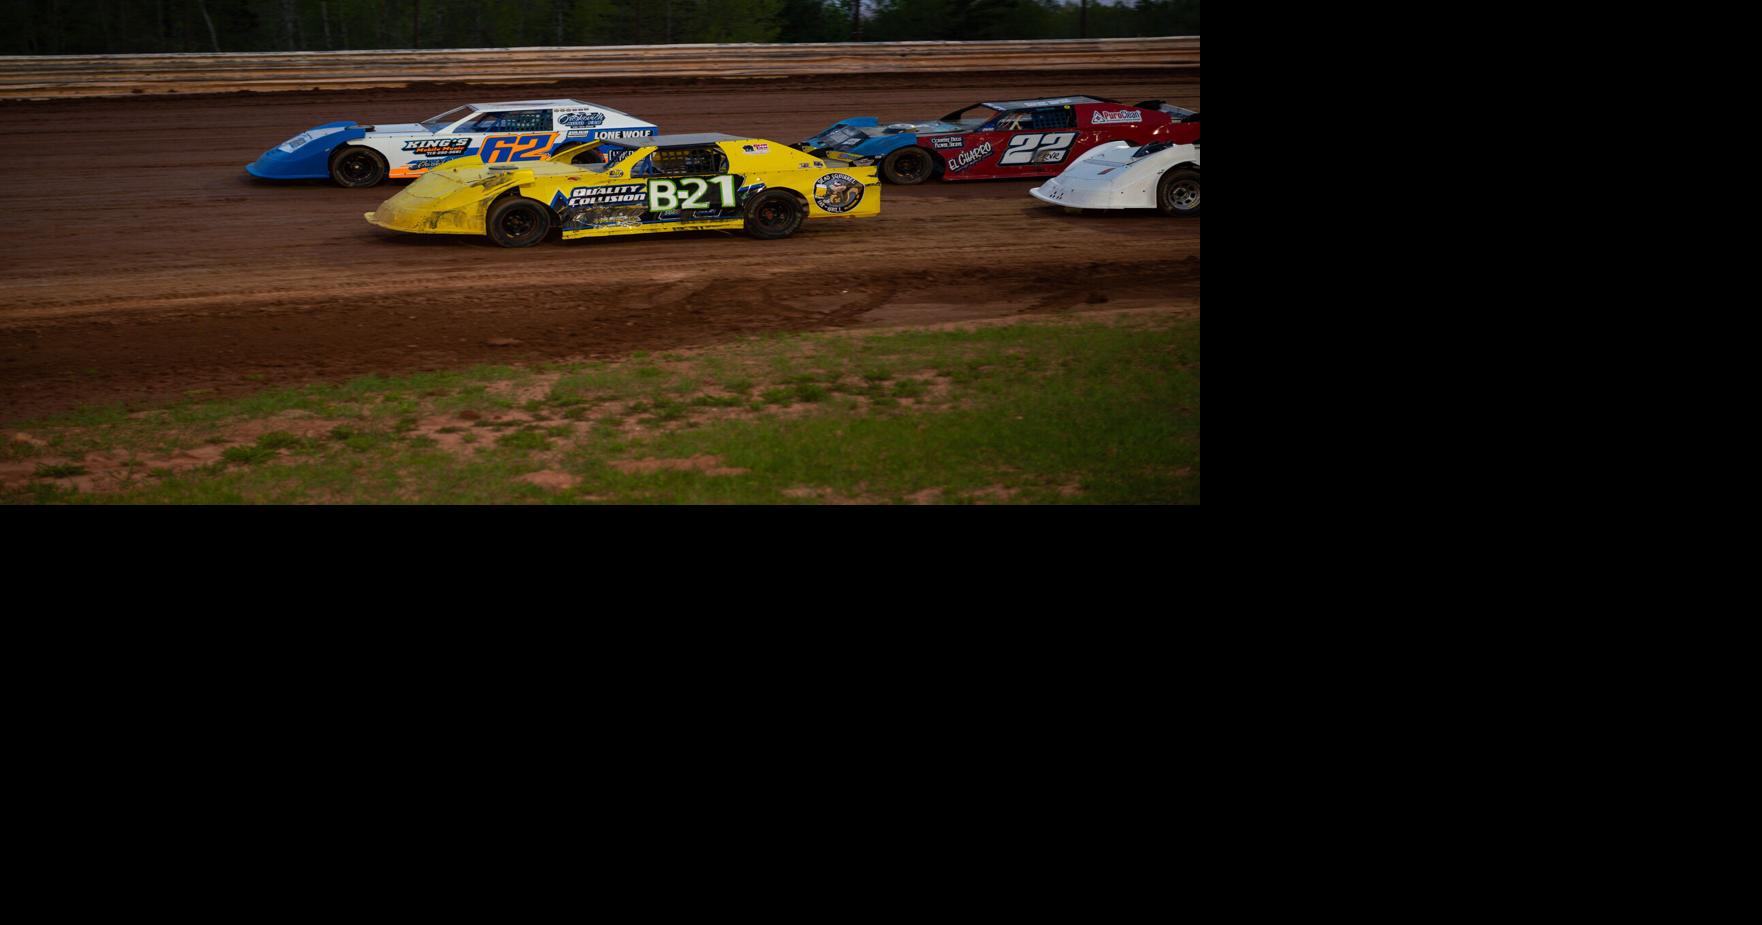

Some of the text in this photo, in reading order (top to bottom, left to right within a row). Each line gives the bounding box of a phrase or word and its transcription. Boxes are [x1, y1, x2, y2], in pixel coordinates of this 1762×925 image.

[405, 138, 469, 149] KING'S
[594, 131, 620, 140] LONE
[622, 130, 651, 138] WOLF
[479, 132, 560, 163] 62
[948, 142, 992, 171] EL CHARRO
[999, 131, 1078, 165] 22
[568, 193, 646, 206] COLLISION
[572, 185, 640, 197] QUALITY
[648, 175, 737, 212] B-21
